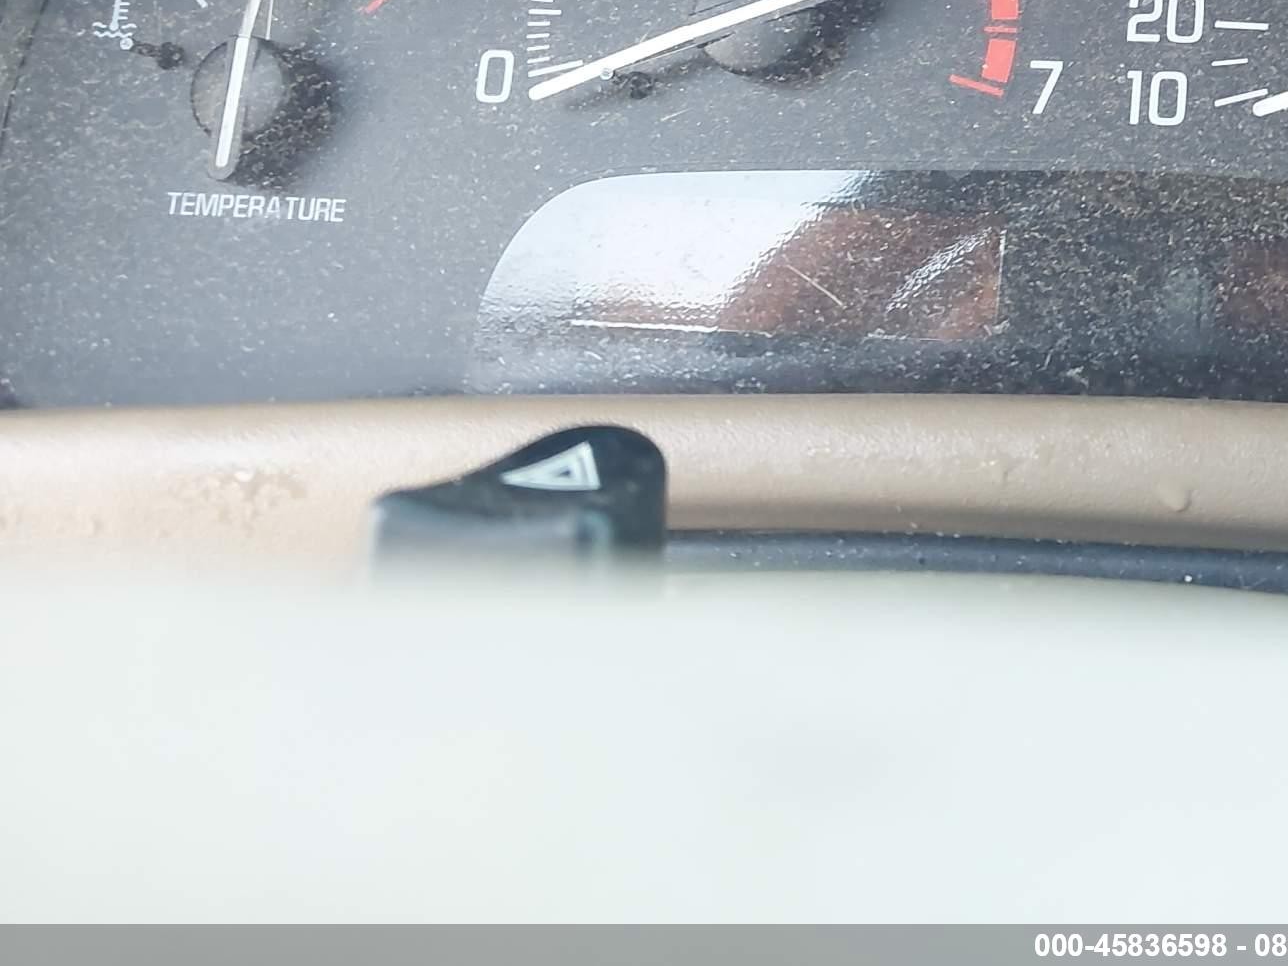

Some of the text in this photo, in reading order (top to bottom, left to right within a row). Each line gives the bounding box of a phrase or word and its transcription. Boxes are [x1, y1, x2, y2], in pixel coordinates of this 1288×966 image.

[476, 50, 514, 103] 0
[1030, 60, 1064, 115] 7
[1127, 71, 1187, 126] 10
[167, 192, 345, 224] TEMPERATURE
